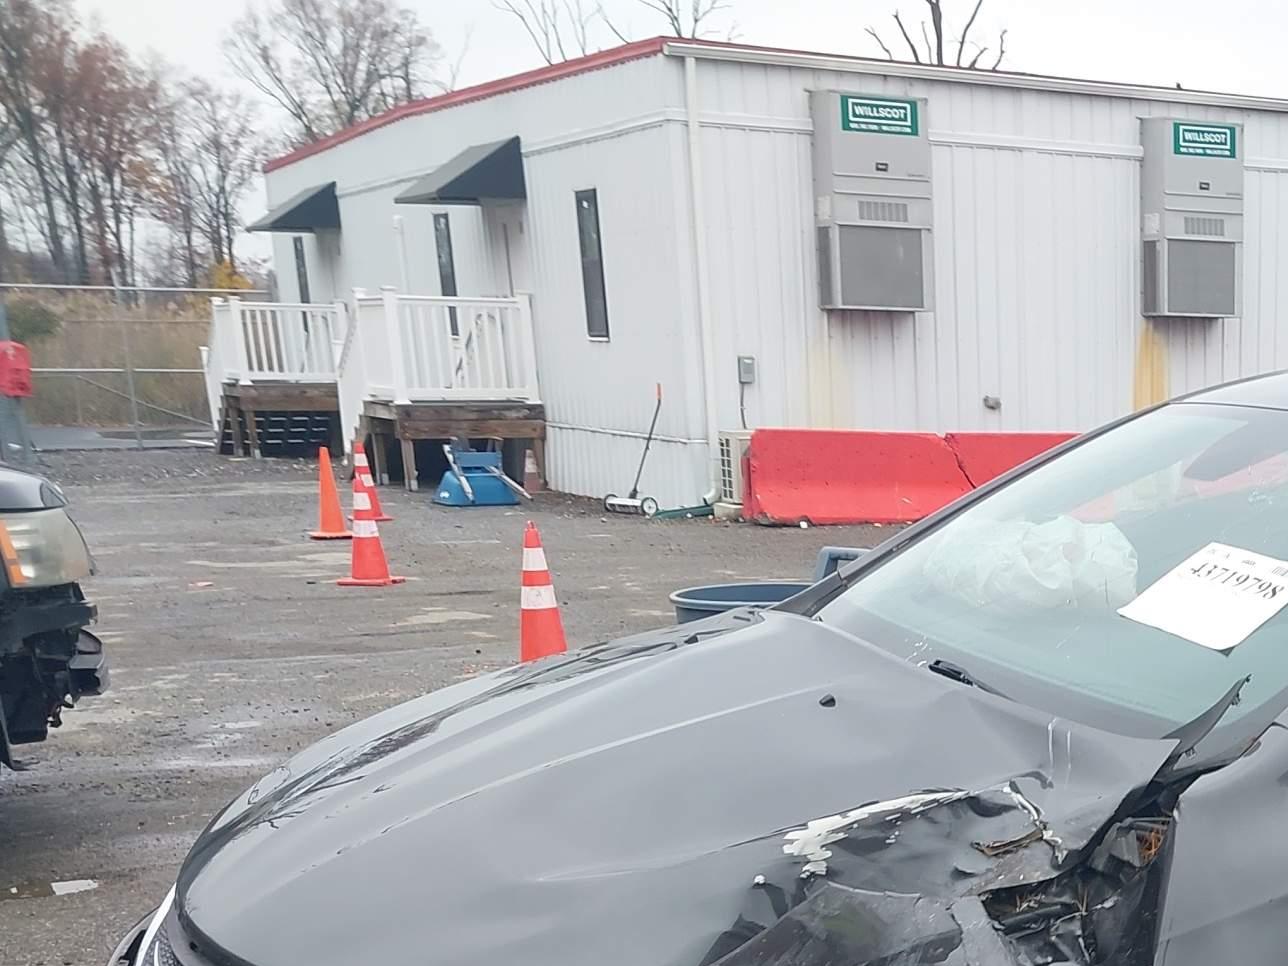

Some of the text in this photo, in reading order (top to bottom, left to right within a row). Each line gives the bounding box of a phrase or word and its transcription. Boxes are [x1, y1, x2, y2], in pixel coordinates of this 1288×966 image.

[853, 104, 906, 119] WILLSCOT
[1183, 131, 1226, 144] WILLSCOT
[1189, 562, 1285, 600] 43719798
